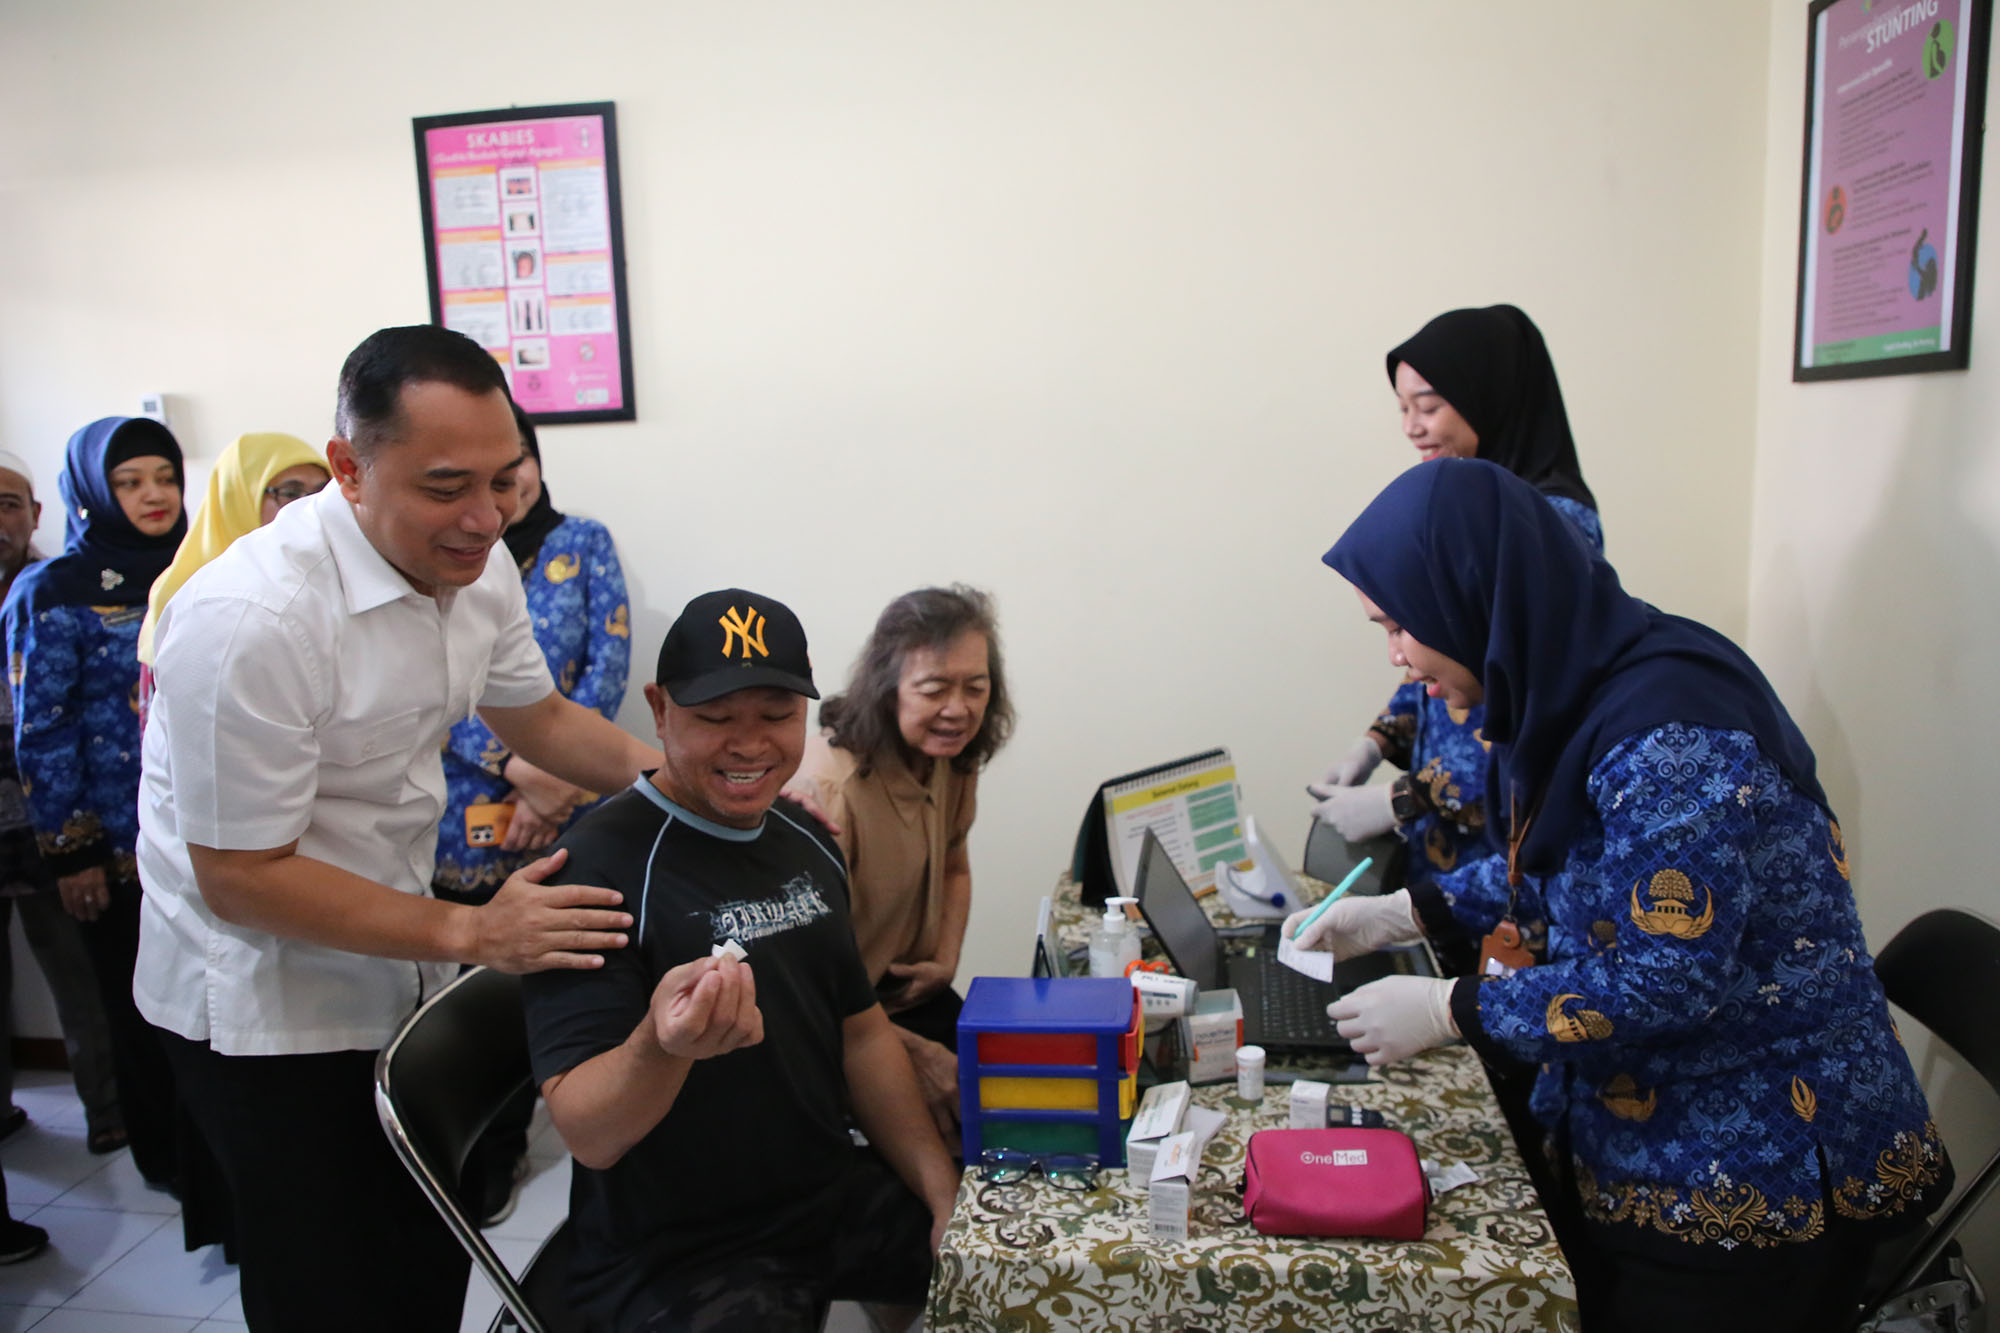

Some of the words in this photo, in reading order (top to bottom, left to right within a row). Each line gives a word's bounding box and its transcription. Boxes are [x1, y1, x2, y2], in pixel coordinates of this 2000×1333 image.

[1866, 0, 1940, 54] STUNTING
[466, 128, 536, 150] SKABIES
[719, 605, 769, 659] NY
